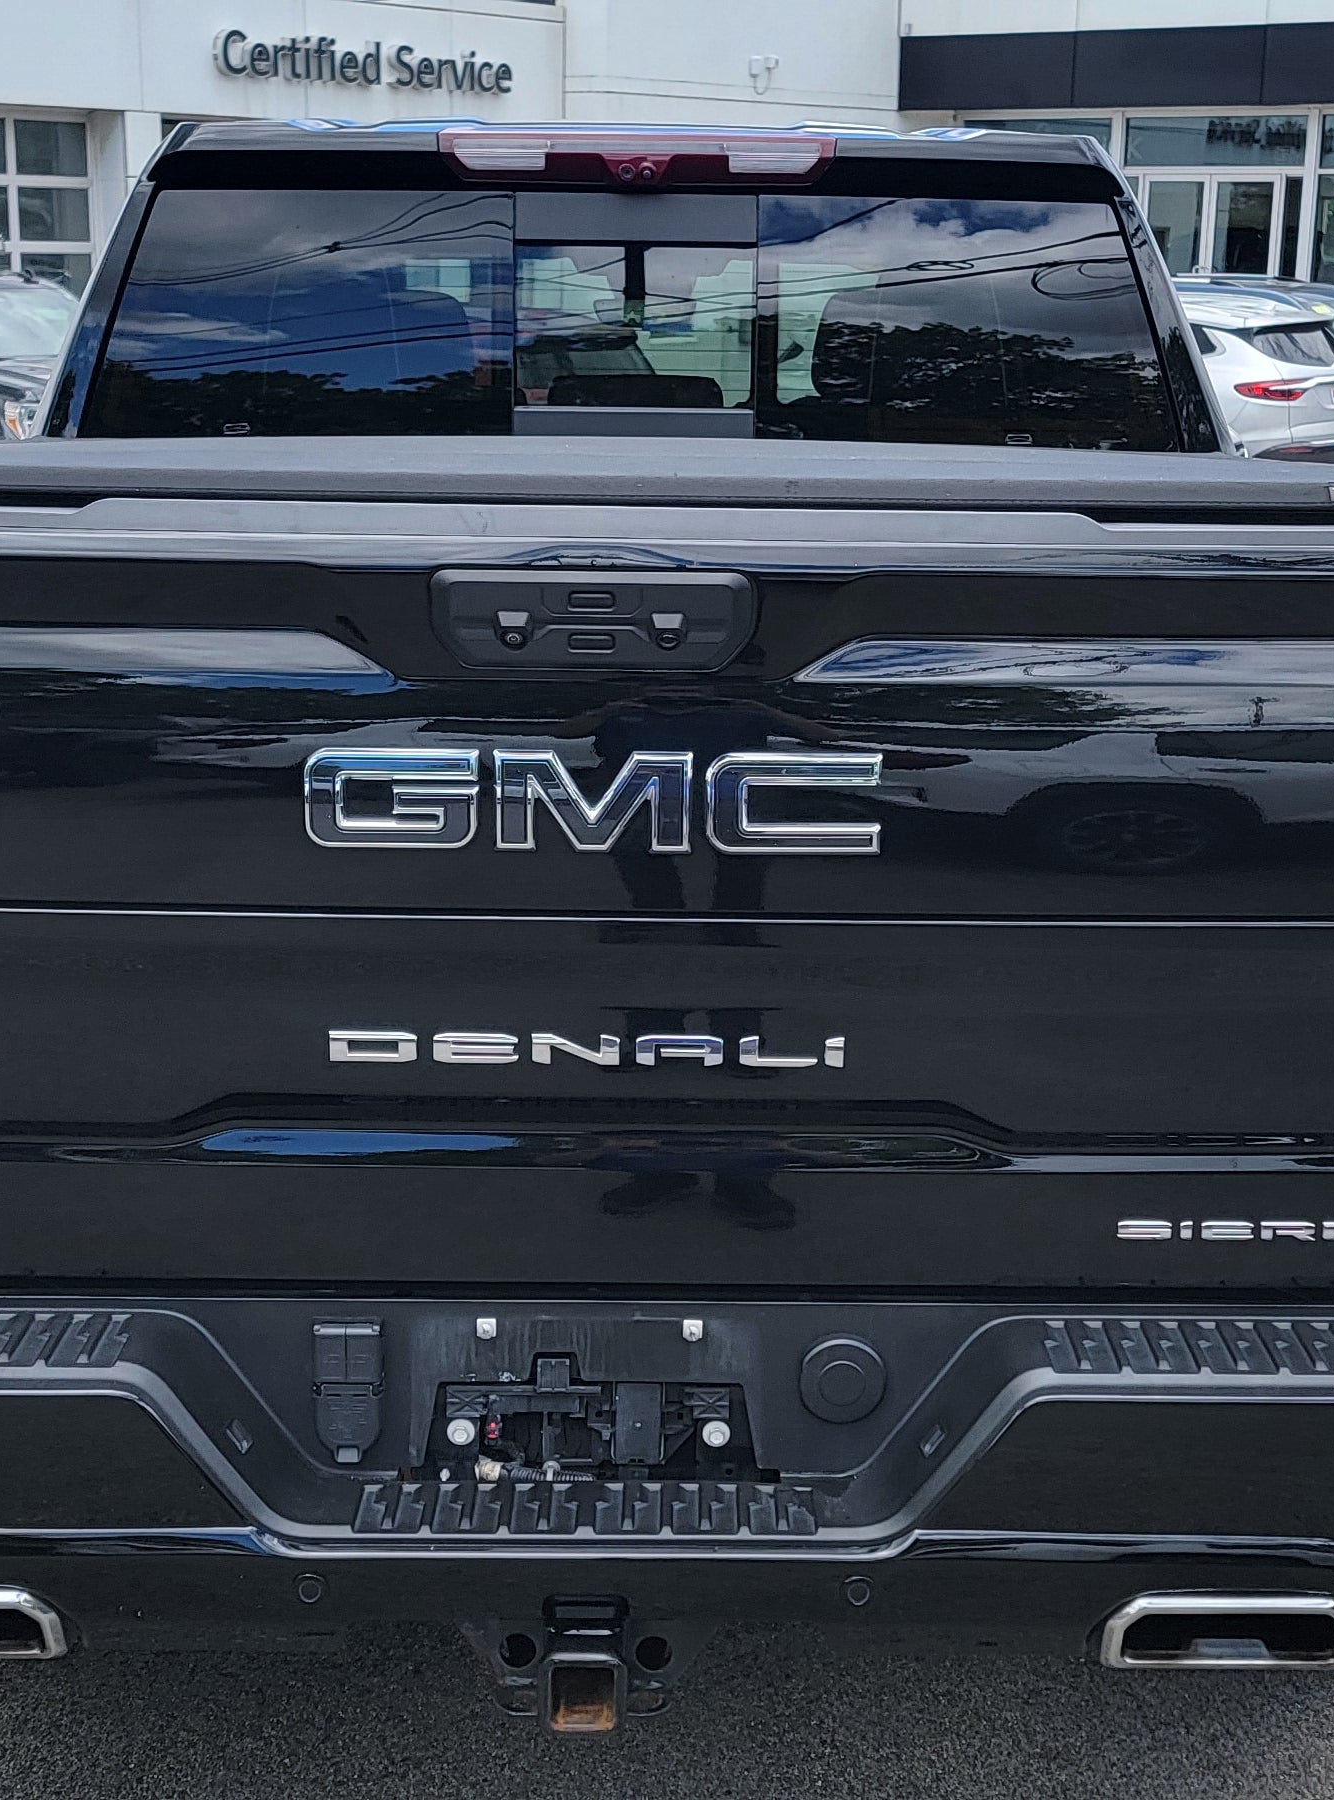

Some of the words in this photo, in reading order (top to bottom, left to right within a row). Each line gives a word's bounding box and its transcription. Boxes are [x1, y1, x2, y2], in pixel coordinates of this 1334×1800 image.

[216, 28, 382, 86] Certified
[388, 44, 513, 95] Service
[304, 747, 884, 856] GMC
[328, 1029, 846, 1069] DENALI
